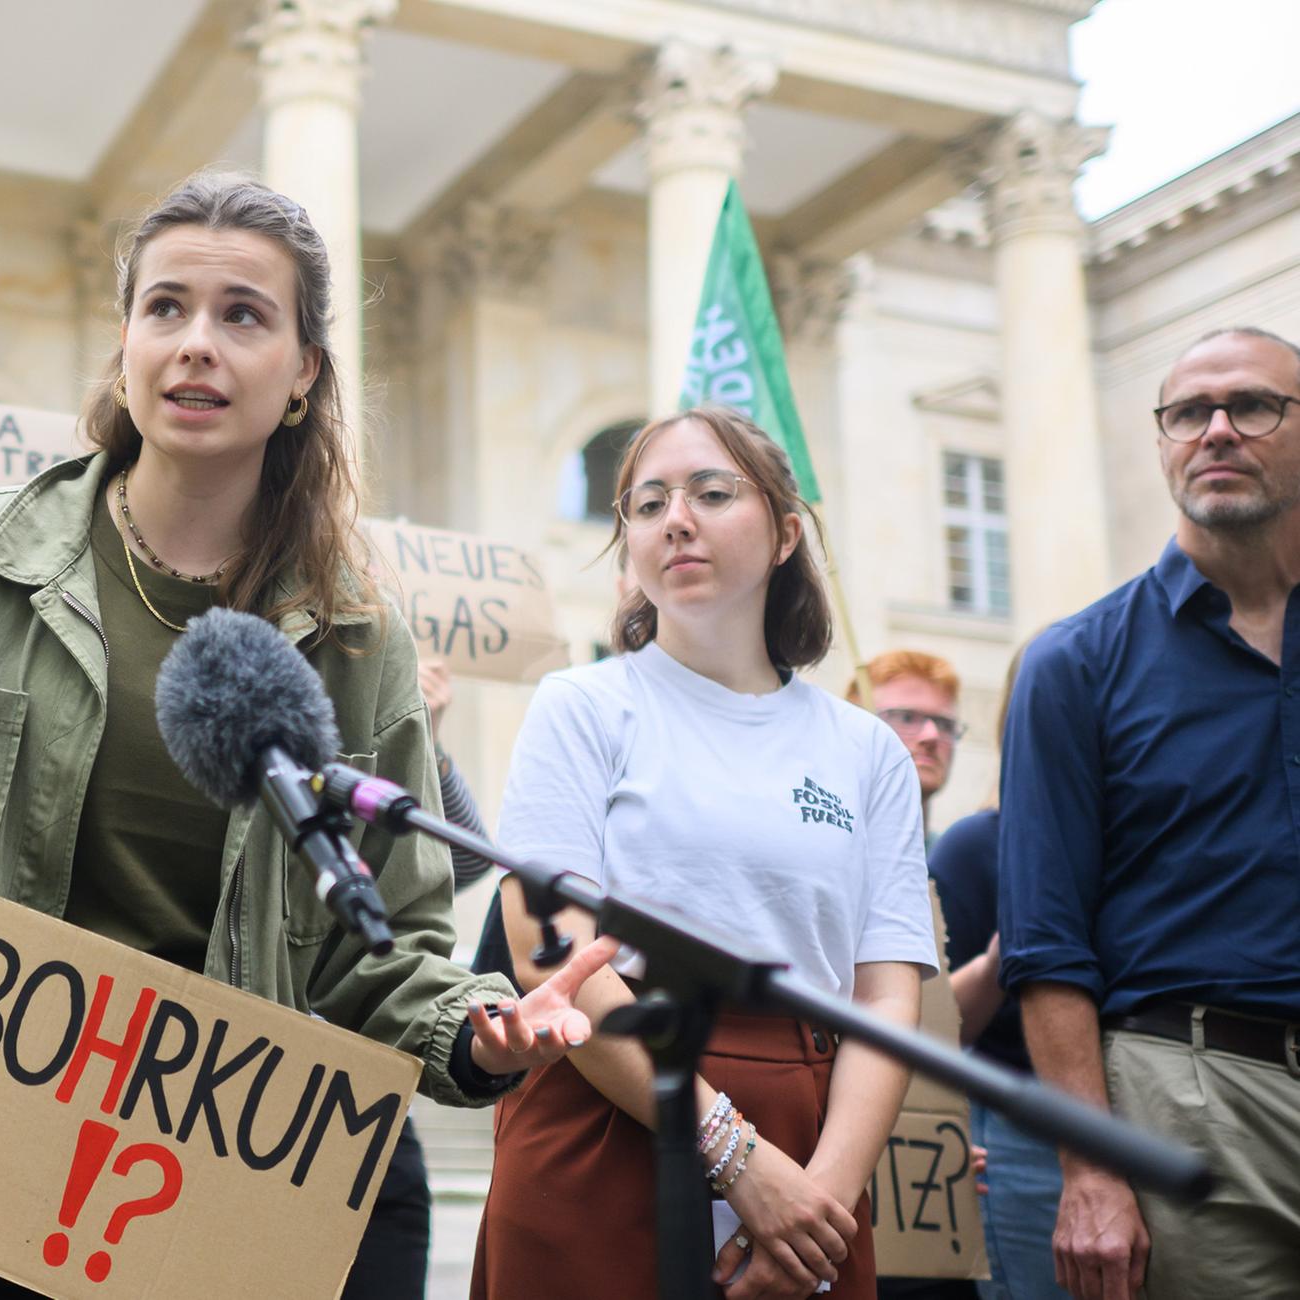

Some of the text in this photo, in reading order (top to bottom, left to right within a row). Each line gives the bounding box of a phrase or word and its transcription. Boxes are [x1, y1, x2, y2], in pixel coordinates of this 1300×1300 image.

[393, 530, 546, 591] NEUES
[411, 588, 510, 661] GAS
[792, 788, 855, 820] FOSSIL
[804, 776, 842, 804] END
[800, 806, 853, 834] FUELS
[41, 1118, 184, 1284] !?
